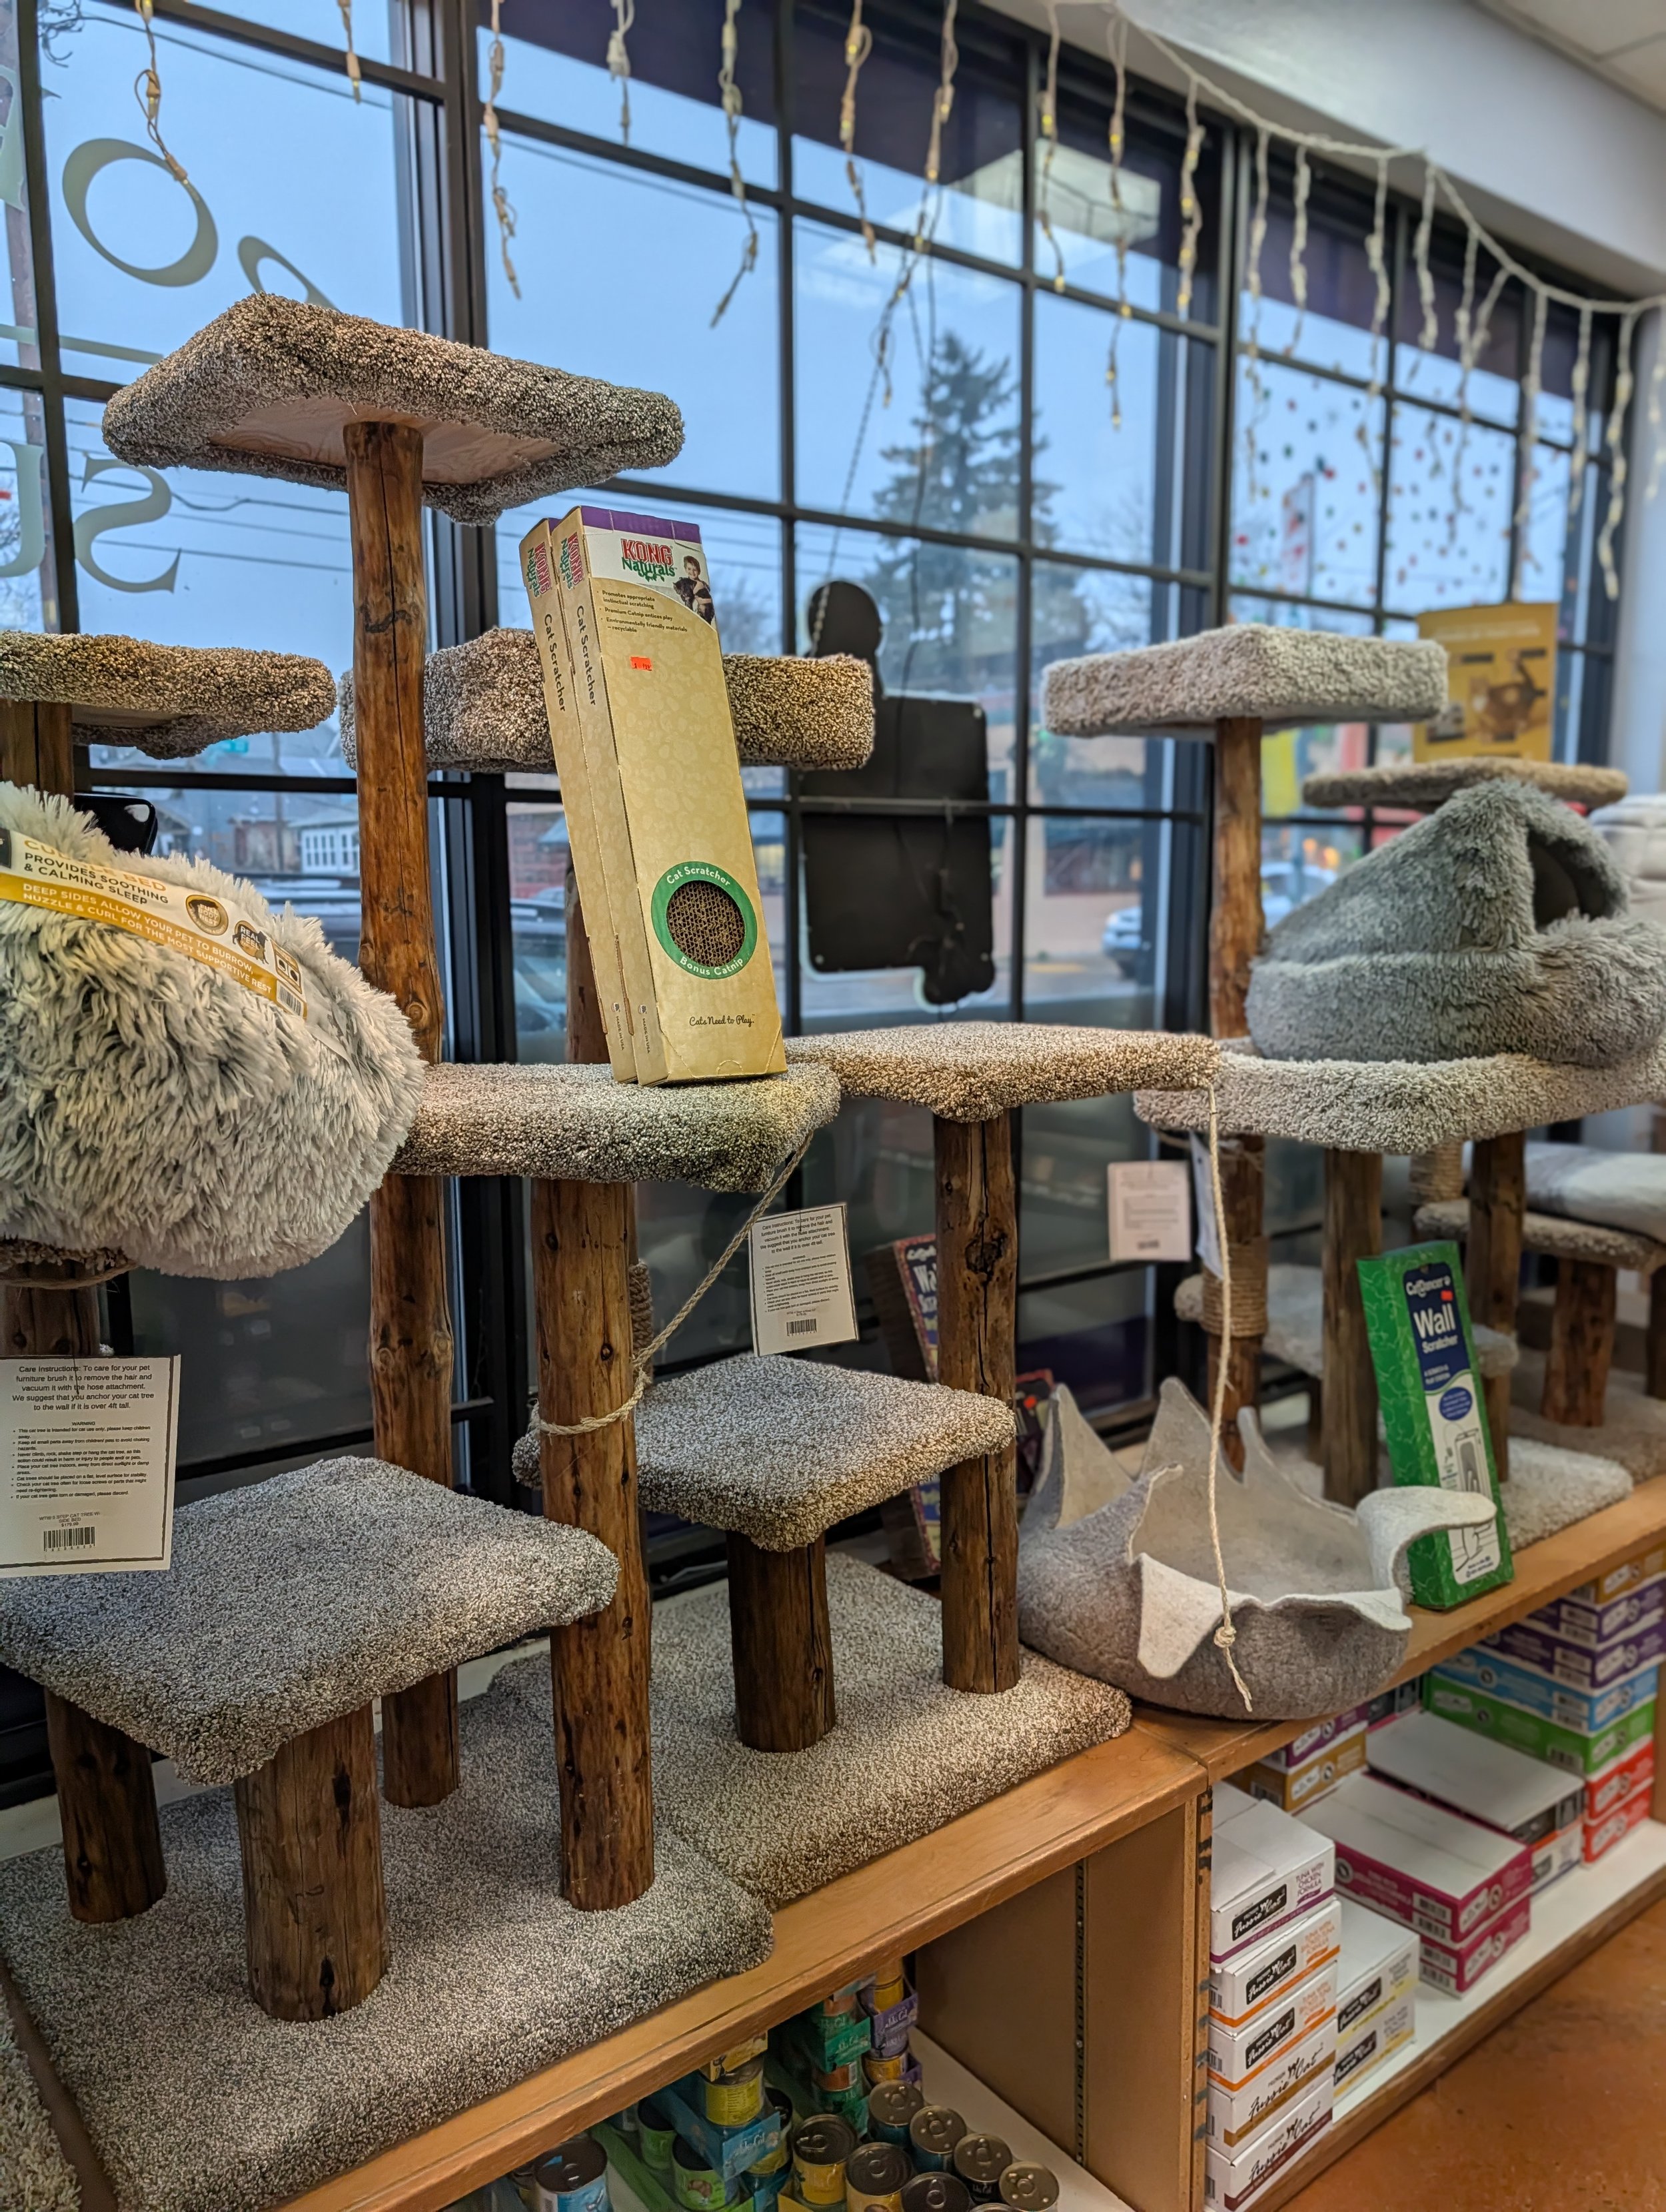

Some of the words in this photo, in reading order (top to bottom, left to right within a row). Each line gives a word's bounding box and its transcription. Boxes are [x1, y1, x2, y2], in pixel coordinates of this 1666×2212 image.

[534, 542, 551, 594] KONG
[560, 538, 573, 590] Naturals
[568, 532, 584, 586] KONG
[620, 538, 673, 566] KONG
[621, 557, 676, 578] Naturals
[526, 548, 540, 598] Naturals
[602, 590, 626, 598] Promotes
[626, 594, 655, 602] appropriate
[606, 617, 645, 628] Environmentally
[544, 614, 554, 641] Cat
[549, 642, 565, 712] Scratcher
[576, 606, 586, 634] Cat
[581, 634, 596, 706] Scratcher
[24, 863, 33, 872] &
[38, 867, 104, 889] CALMING
[109, 885, 147, 905] SLEEP
[25, 852, 96, 879] PROVIDES
[101, 875, 169, 903] SOOTHING
[666, 869, 683, 884] Cat
[684, 866, 731, 887] Scratcher
[23, 883, 57, 895] DEEP
[61, 891, 97, 905] SIDES
[101, 900, 141, 919] ALLOW
[144, 916, 173, 934] YOUR
[175, 930, 194, 943] PET
[196, 939, 210, 950] TO
[213, 947, 253, 975] BURROW,
[198, 908, 218, 920] BODY
[23, 893, 73, 909] NUZZLE
[87, 907, 118, 921] CURL
[121, 917, 143, 931] FOR
[145, 926, 165, 940] THE
[167, 937, 193, 953] MOST
[196, 949, 250, 982] SUPPORTIVE
[251, 978, 272, 994] REST
[241, 925, 260, 943] REAL
[241, 934, 260, 950] FEEL
[680, 956, 710, 975] Bonus
[714, 958, 744, 975] Catnip
[689, 1016, 707, 1026] Cats
[707, 1015, 726, 1025] Need
[1413, 1303, 1456, 1339] Wall
[1422, 1335, 1458, 1354] Scratcher
